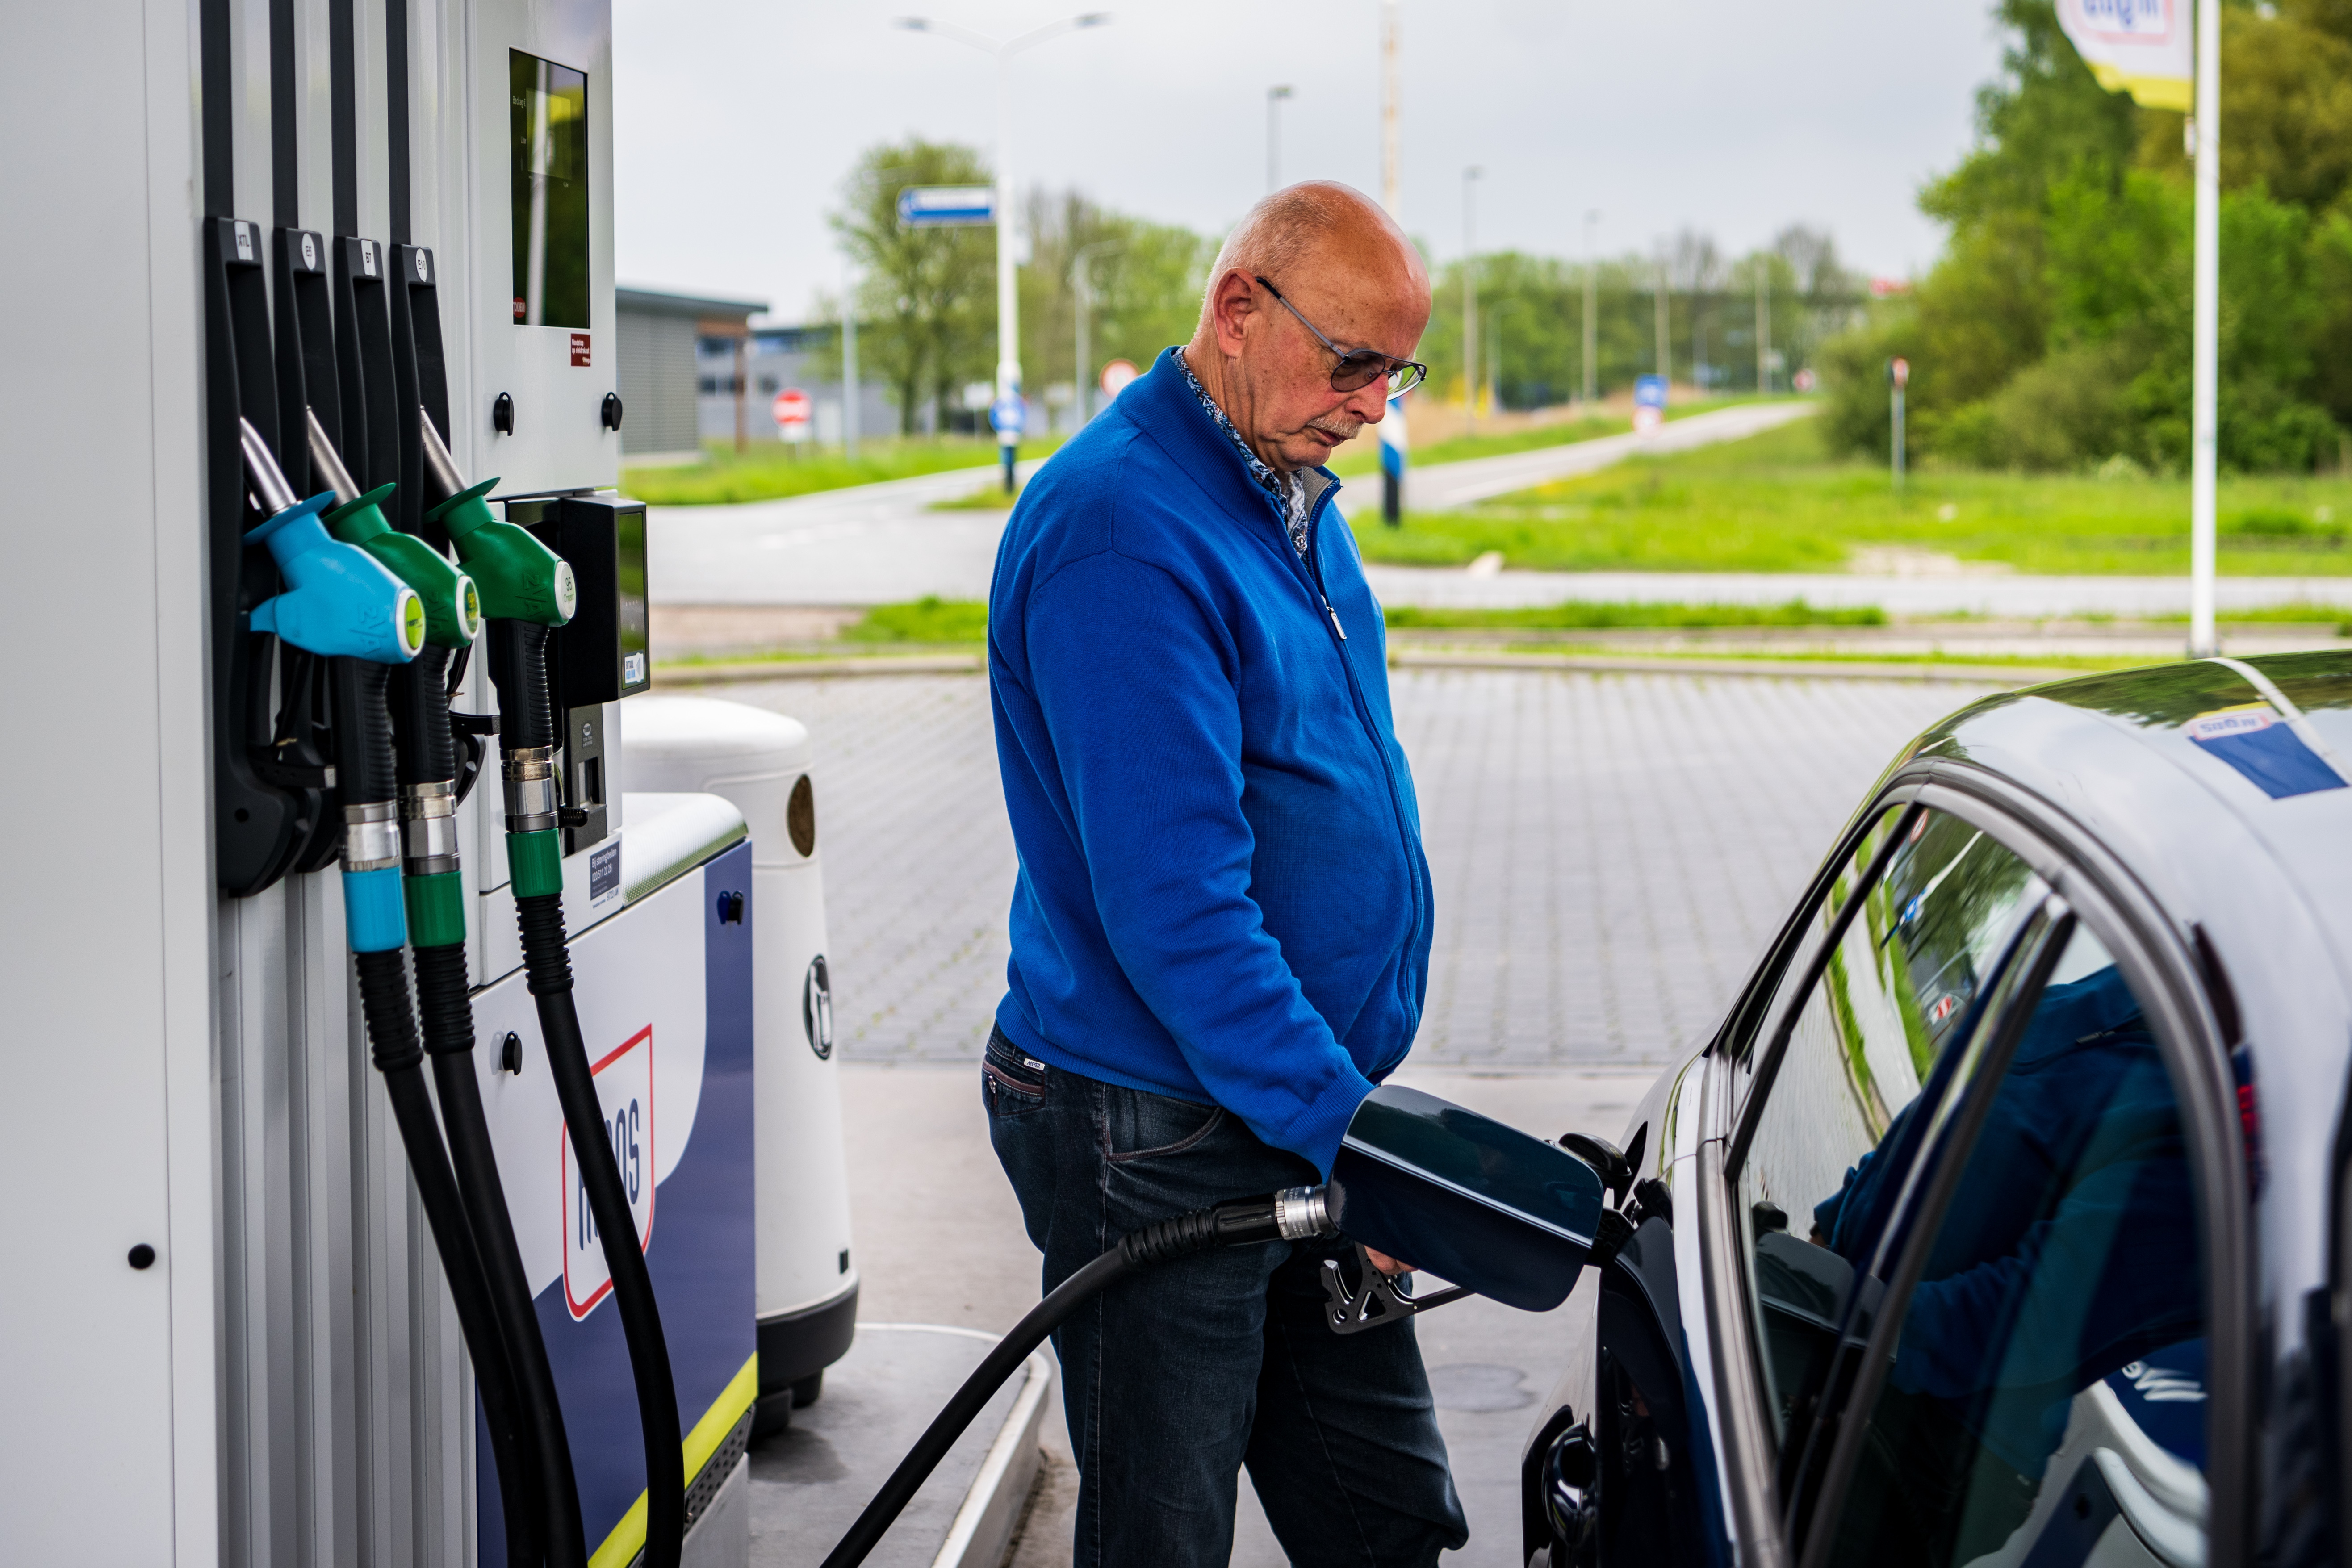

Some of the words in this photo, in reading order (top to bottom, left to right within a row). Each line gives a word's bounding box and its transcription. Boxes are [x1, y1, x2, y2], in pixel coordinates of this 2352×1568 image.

[512, 95, 523, 108] Bedrag
[238, 234, 250, 247] XTL
[305, 246, 312, 257] E5
[365, 252, 372, 263] B7
[418, 259, 426, 270] E10
[565, 577, 572, 591] 95
[596, 853, 607, 864] storing
[1027, 1061, 1040, 1069] MEYER
